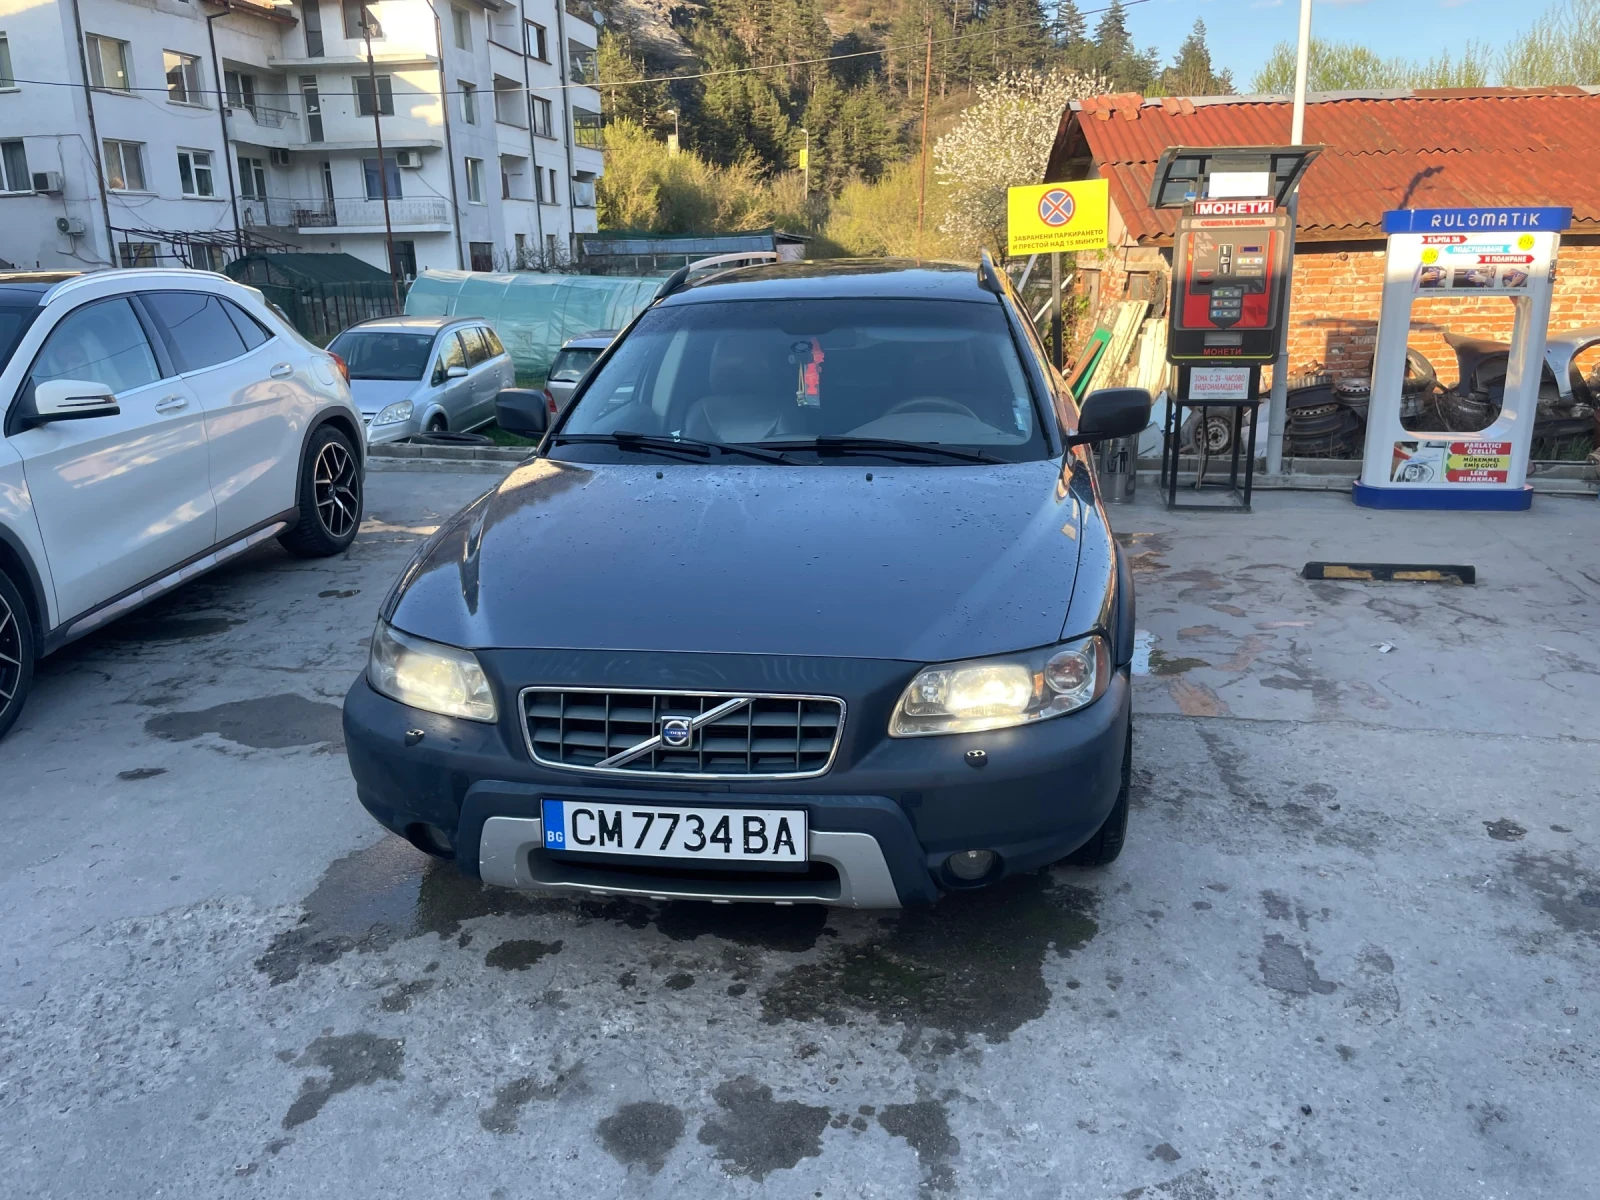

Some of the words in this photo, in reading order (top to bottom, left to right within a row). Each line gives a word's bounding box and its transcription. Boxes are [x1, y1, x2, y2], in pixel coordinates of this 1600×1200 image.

[1200, 202, 1269, 214] МОНЕТИ
[1014, 233, 1053, 242] ЗАБРАНЕНИ
[1054, 229, 1104, 239] ПАРКИРАНЕТО
[1019, 241, 1049, 249] ПРЕСТОЙ
[1075, 237, 1104, 245] МИНУТИ
[1453, 245, 1504, 254] ПОДСУШАВАНЕ
[1203, 348, 1242, 356] МОНЕТИ
[1194, 383, 1244, 391] ВИДЕОНАБЛЮДЕНИЕ
[547, 830, 564, 842] BG
